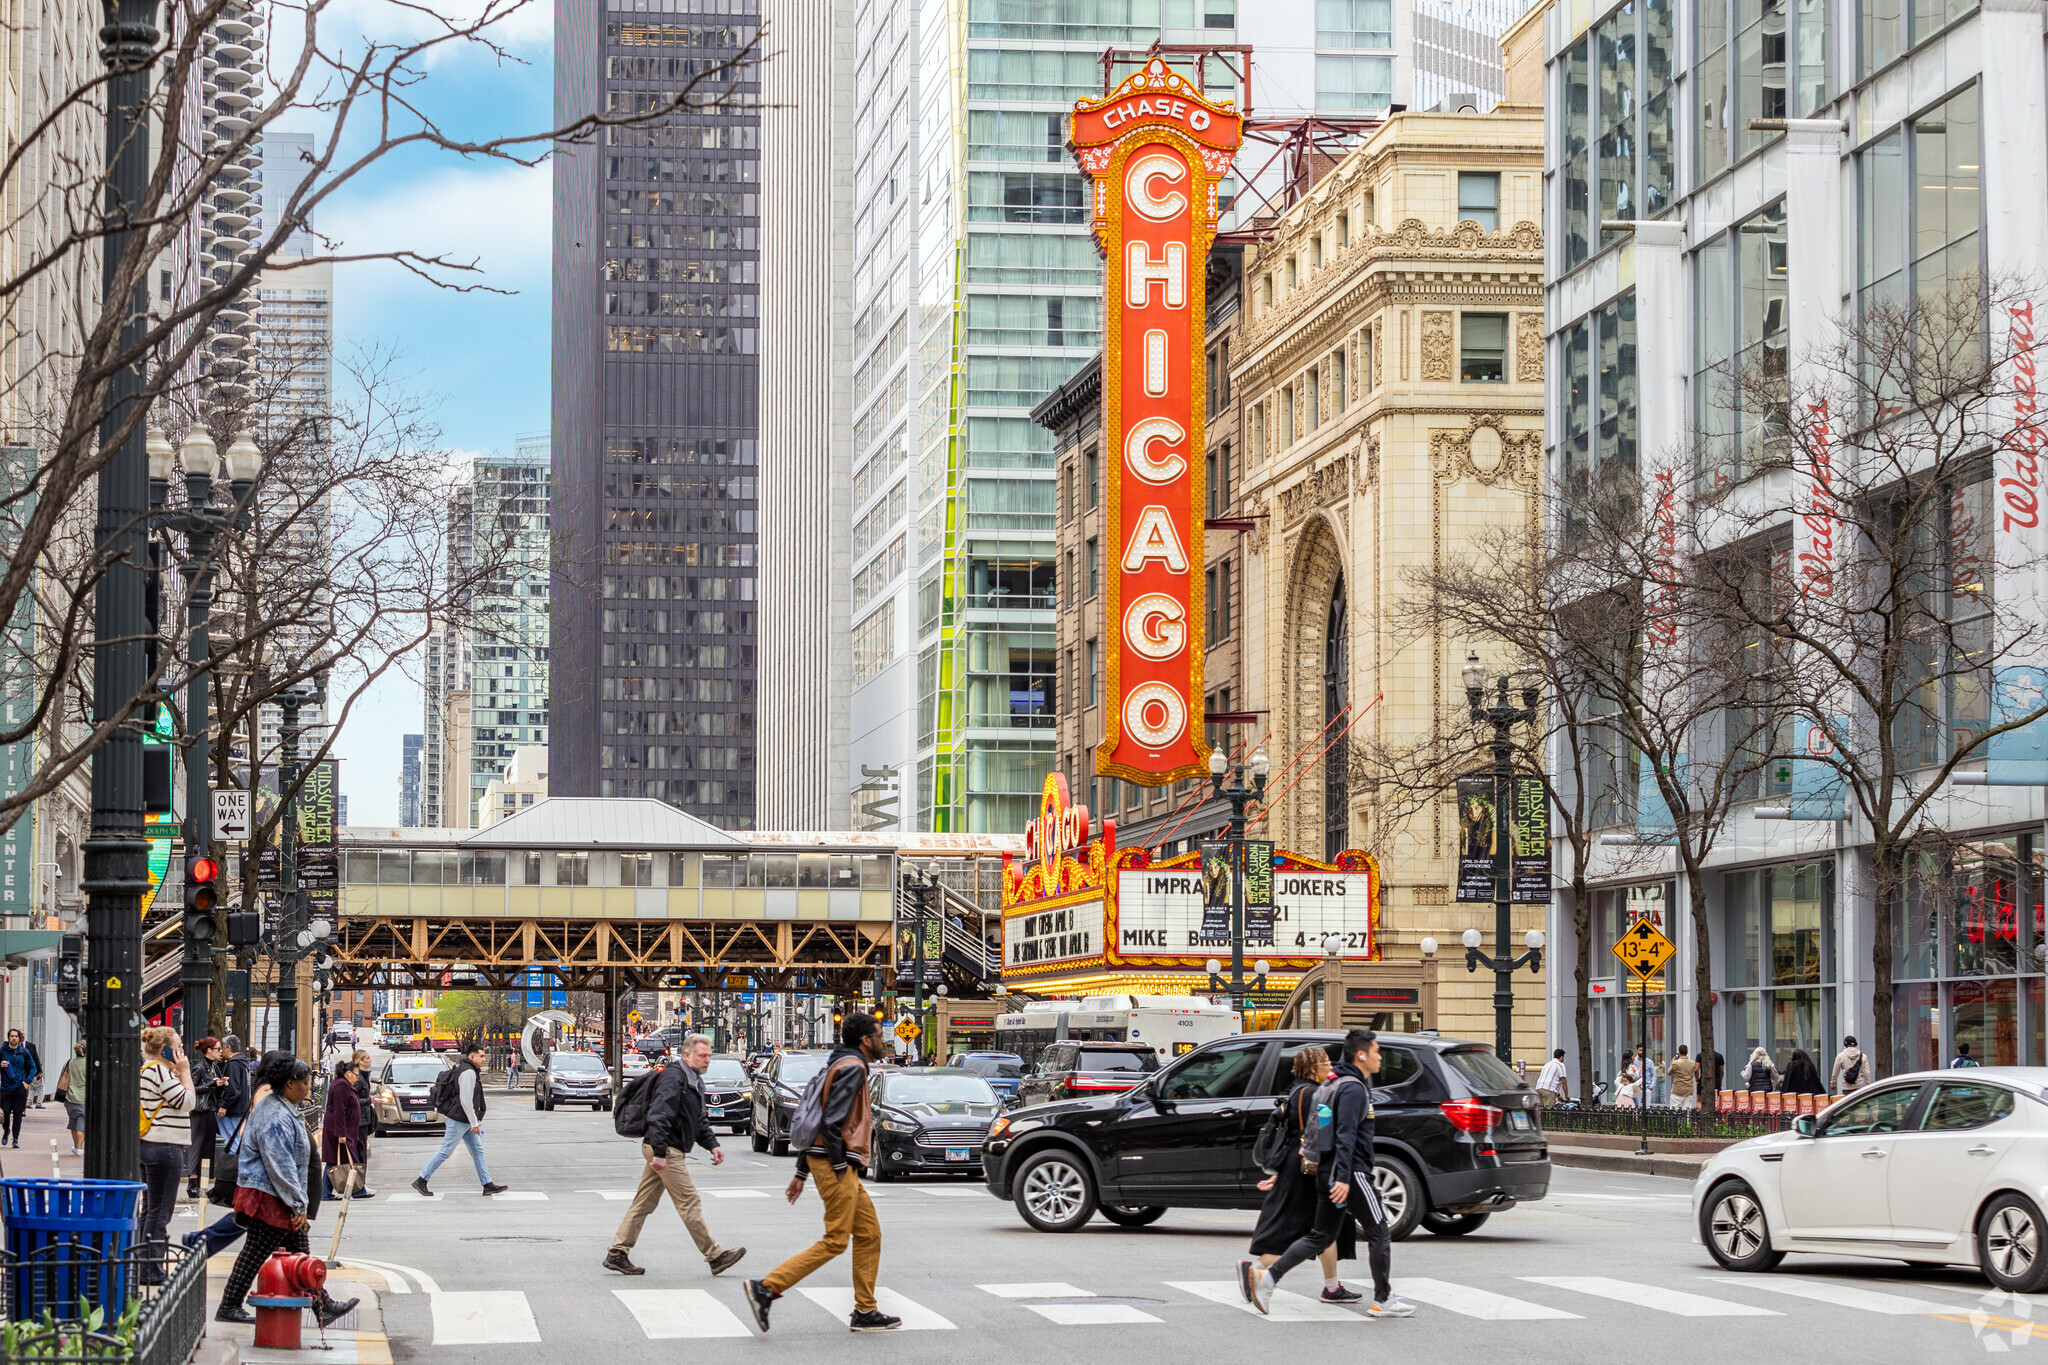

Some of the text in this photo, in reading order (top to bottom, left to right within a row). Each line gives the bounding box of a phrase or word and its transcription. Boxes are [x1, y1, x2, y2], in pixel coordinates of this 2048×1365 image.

[1103, 99, 1187, 129] CHASE
[2000, 299, 2048, 533] Walgreens
[1122, 154, 1188, 751] CHICAGO
[1798, 398, 1843, 601] Walgreens
[217, 809, 246, 820] WAY
[218, 795, 246, 806] ONE
[303, 805, 316, 843] DREAM
[317, 763, 332, 843] MIDSUMMER
[1518, 779, 1530, 857] NIGHT'S DREAM
[1531, 779, 1545, 857] MIDSUMMER
[4, 829, 16, 901] ENTER
[1249, 844, 1258, 904] NIGHT'S DREAM
[1259, 844, 1270, 904] MIDSUMMER
[1279, 878, 1347, 896] JOKERS
[1123, 930, 1167, 946] MIKE
[1622, 942, 1665, 958] 13'-4"
[1178, 1044, 1193, 1054] 146
